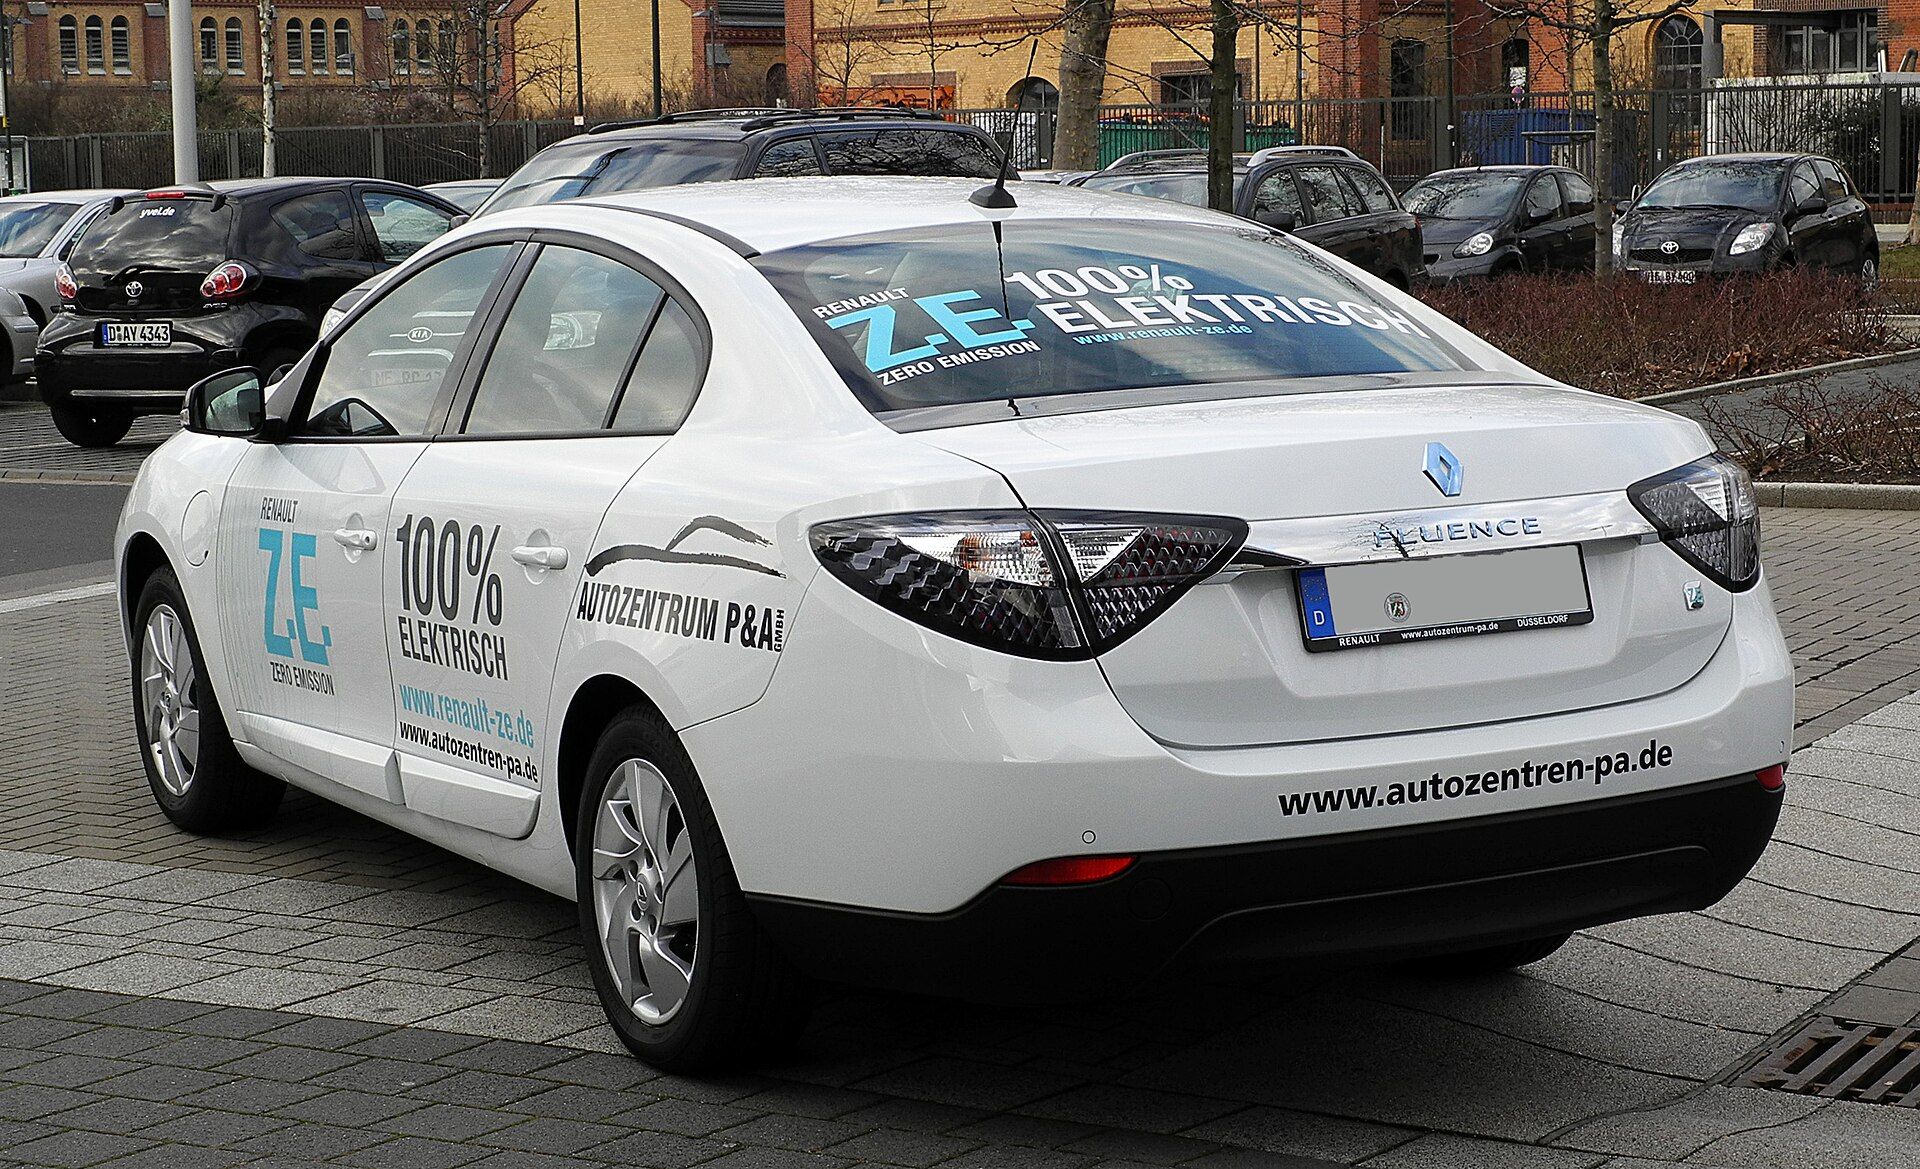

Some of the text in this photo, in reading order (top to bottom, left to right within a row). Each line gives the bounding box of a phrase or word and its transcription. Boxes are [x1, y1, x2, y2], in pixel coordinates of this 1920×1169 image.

[1004, 264, 1195, 299] 100%
[812, 287, 909, 319] RENAULT
[1035, 294, 1431, 339] ELEKTRISCH
[108, 326, 169, 341] D AY 4343
[411, 330, 428, 339] KIA
[1073, 324, 1254, 346] www.renault-ze.de
[876, 340, 1042, 386] ZERO EMISSION
[260, 497, 299, 524] RENAULT
[1373, 517, 1542, 547] FLUENCE
[396, 514, 503, 626] 100%
[577, 581, 774, 651] AUTOZENTRUM P&A
[774, 609, 785, 652] GMBH
[1313, 610, 1325, 626] D
[1338, 613, 1569, 648] RENAULT www.autozentrum-pa.de DÜSSELDORF
[398, 616, 509, 681] ELEKTRISCH
[269, 661, 335, 696] ZERO EMISSION
[399, 684, 535, 748] www.renault-ze.de
[399, 721, 539, 783] www.autozentren-pa.de
[1277, 739, 1673, 817] www.autozentren-pa.de
